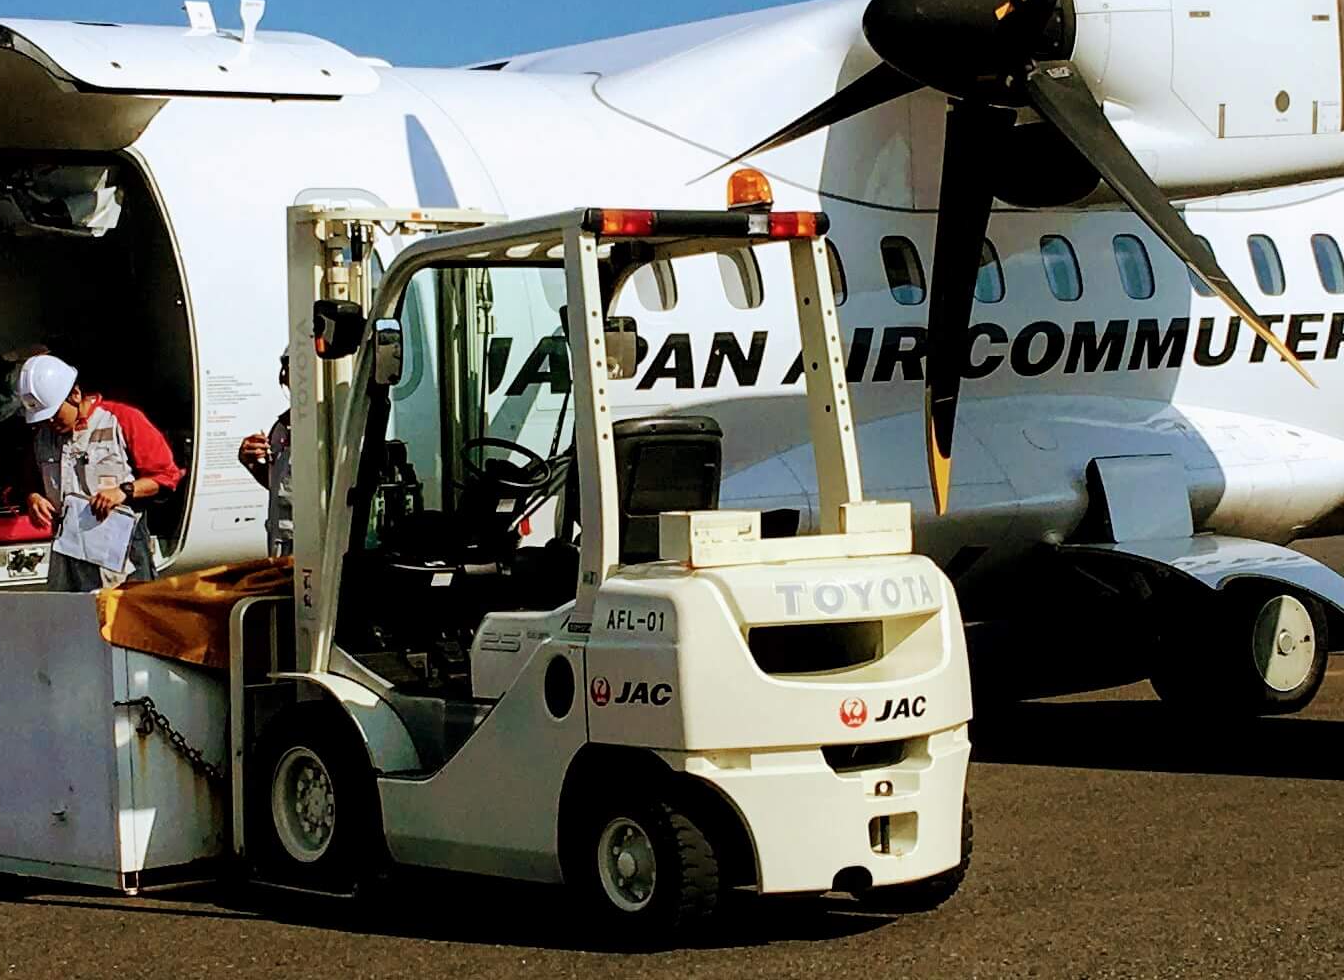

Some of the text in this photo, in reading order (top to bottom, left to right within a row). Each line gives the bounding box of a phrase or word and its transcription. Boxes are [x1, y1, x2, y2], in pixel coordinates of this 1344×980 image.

[486, 329, 770, 397] JAAN
[774, 574, 935, 617] TOYOTA
[606, 609, 666, 632] AFL-01
[614, 681, 673, 706] JAC
[874, 695, 927, 722] JAC
